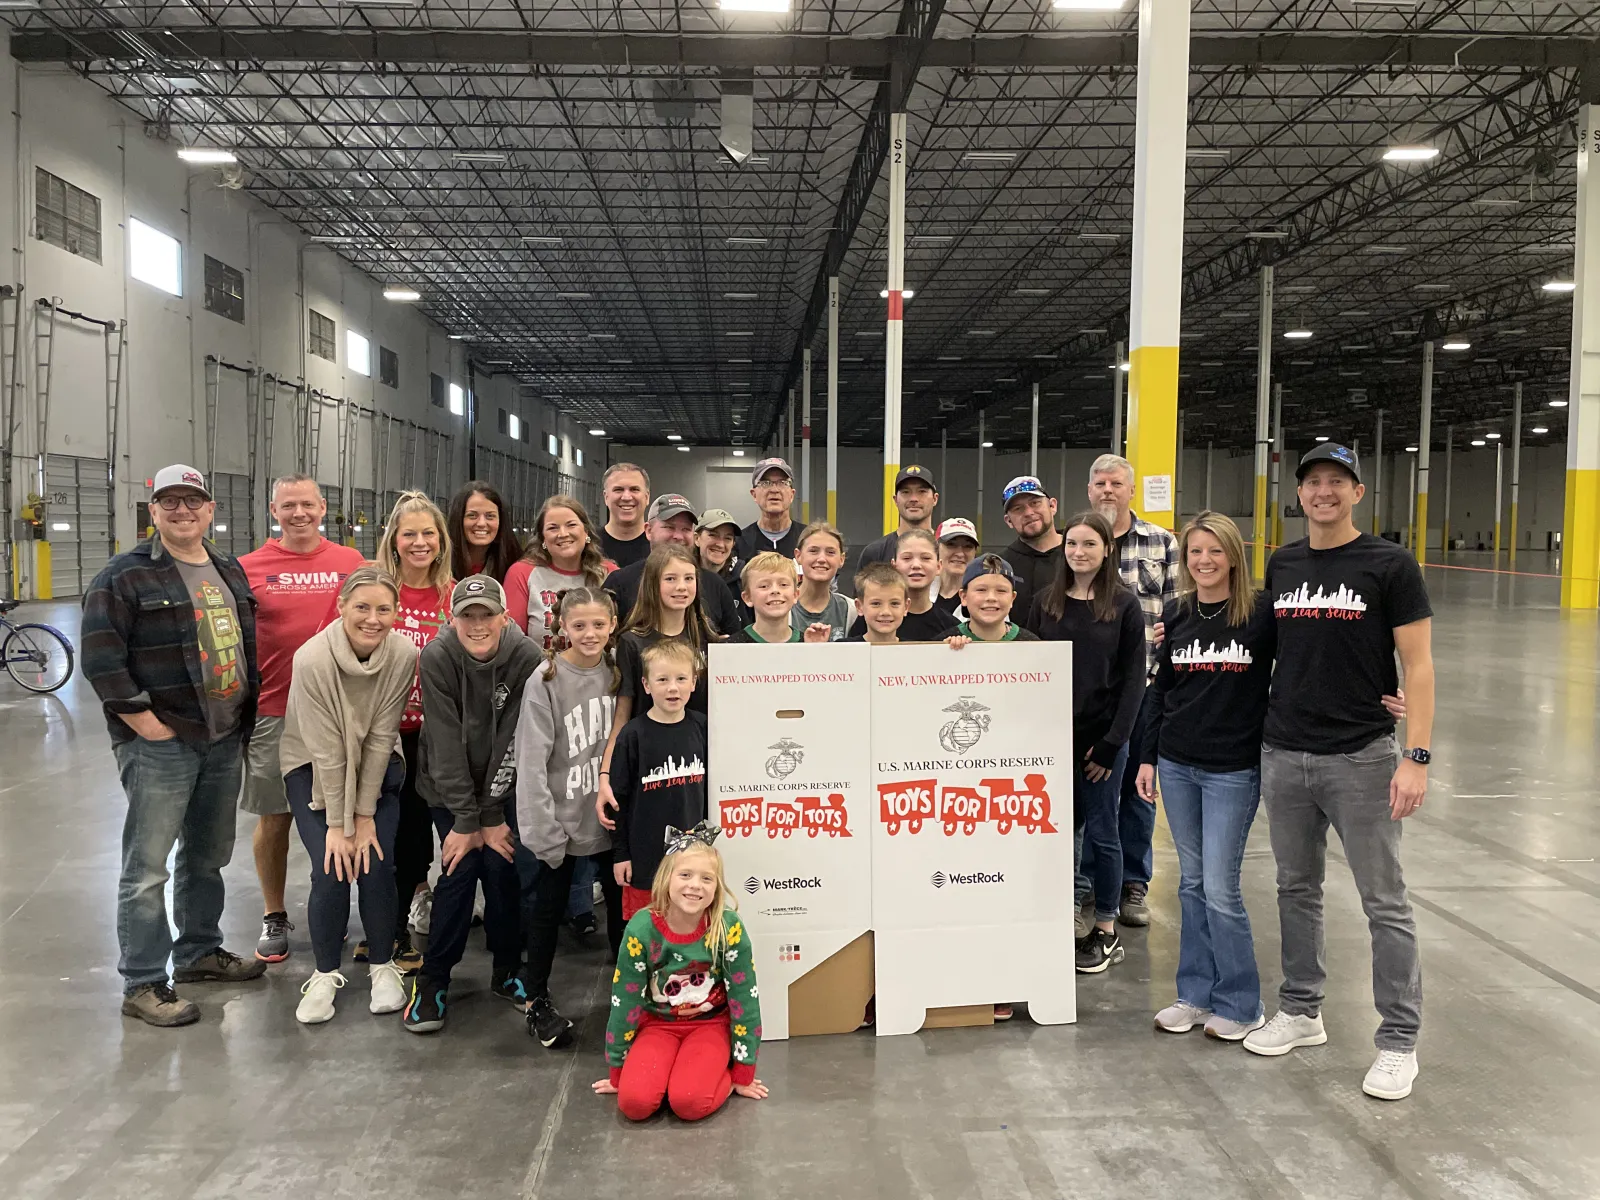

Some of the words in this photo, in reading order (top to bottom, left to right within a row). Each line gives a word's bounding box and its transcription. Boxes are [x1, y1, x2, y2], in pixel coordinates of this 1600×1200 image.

[54, 491, 68, 505] 126
[278, 571, 339, 585] SWIM
[715, 675, 740, 685] NEW,
[741, 674, 801, 684] UNWRAPPED
[802, 673, 827, 683] TOYS
[828, 673, 855, 682] ONLY
[878, 676, 908, 687] NEW,
[911, 674, 985, 686] UNWRAPPED
[987, 673, 1017, 684] TOYS
[1019, 672, 1052, 683] ONLY
[877, 762, 900, 772] U.S.
[903, 760, 953, 771] MARINE
[955, 758, 997, 770] CORPS
[1000, 756, 1055, 768] RESERVE
[719, 785, 736, 793] U.S.
[739, 783, 776, 792] MARINE
[776, 782, 808, 791] CORPS
[810, 781, 851, 790] RESERVE
[883, 787, 932, 816] TOYS
[943, 792, 981, 818] FOR
[993, 794, 1043, 821] TOTS
[723, 803, 760, 824] TOYS
[767, 806, 796, 826] FOR
[804, 808, 842, 828] TOTS
[763, 876, 822, 890] WestRock
[949, 871, 1005, 885] WestRock
